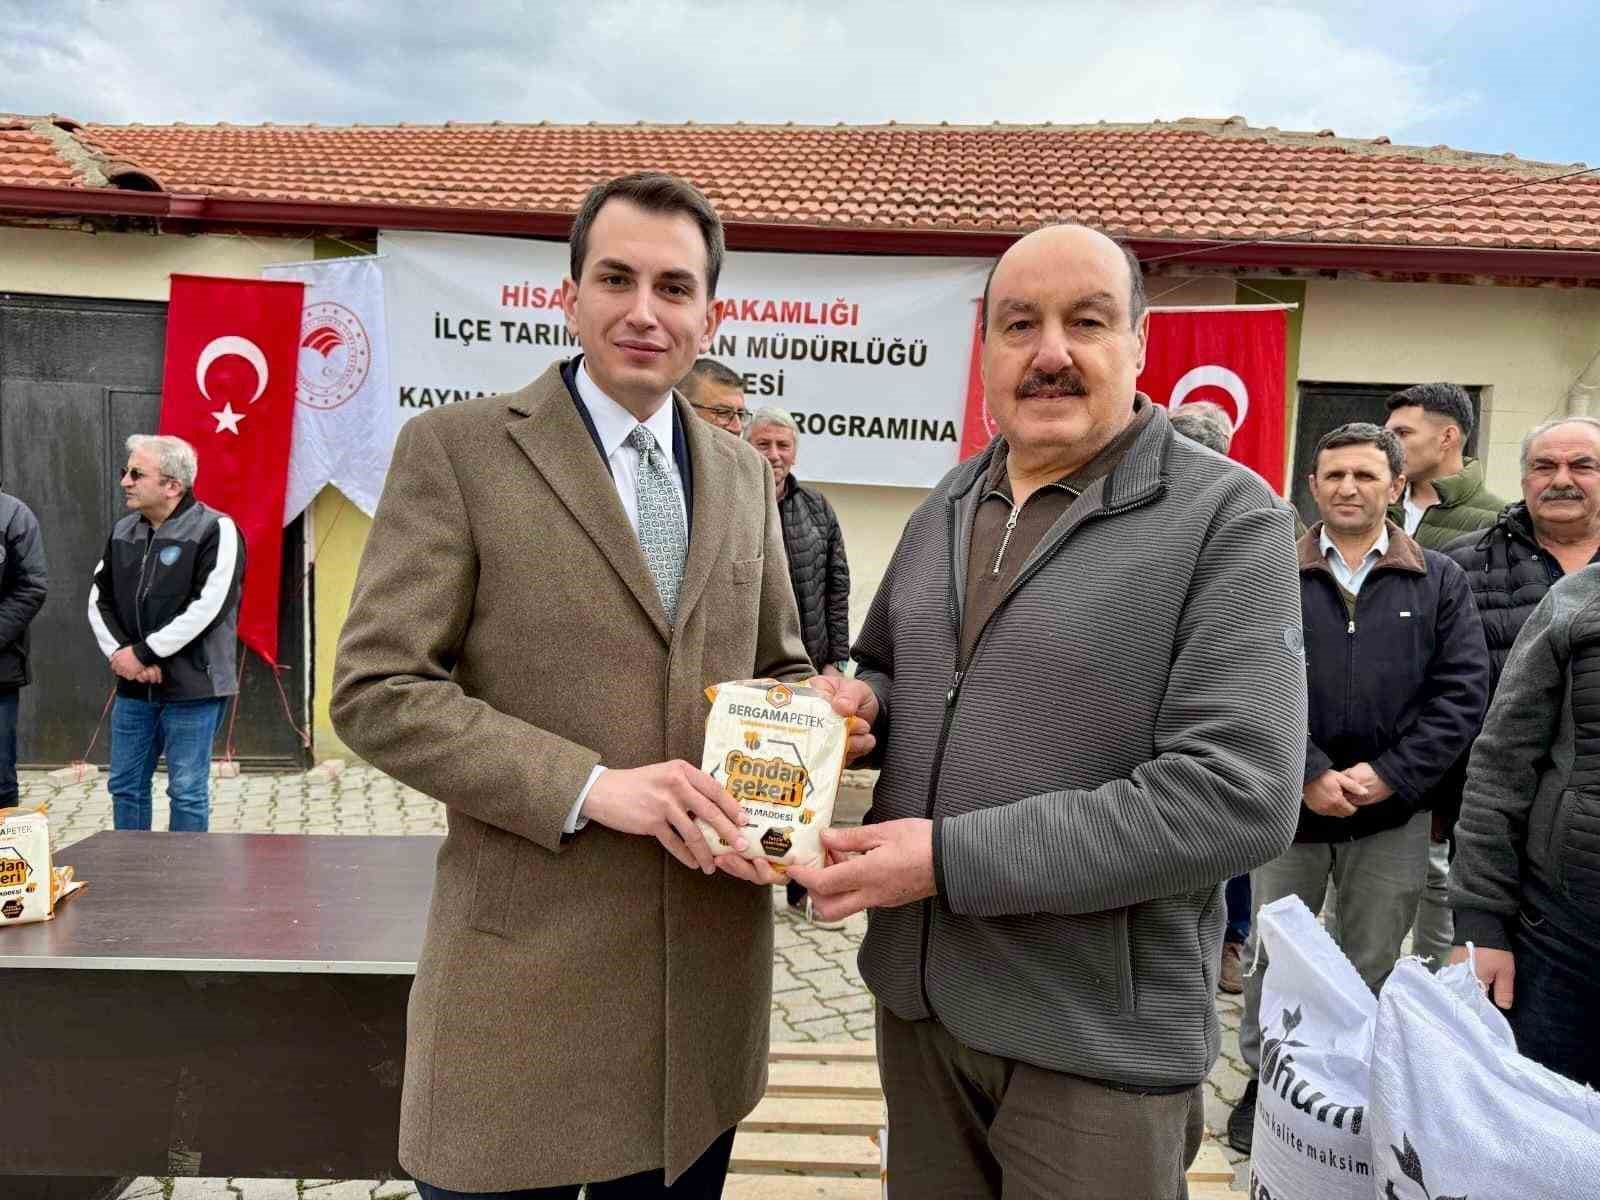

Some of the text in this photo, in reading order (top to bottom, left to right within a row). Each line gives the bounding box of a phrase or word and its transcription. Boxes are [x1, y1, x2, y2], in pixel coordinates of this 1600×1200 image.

[501, 281, 860, 326] HİSA AKAMLIĞI
[434, 312, 491, 346] İLÇE
[500, 321, 582, 347] TARIM
[746, 332, 928, 367] MÜDÜRLÜĞÜ
[743, 369, 784, 397] ESİ
[790, 412, 958, 442] ROGRAMINA
[728, 703, 824, 729] BERGAMAPETEK
[729, 754, 806, 784] fondan
[1271, 1112, 1303, 1152] kalite
[1306, 1145, 1375, 1177] maksim
